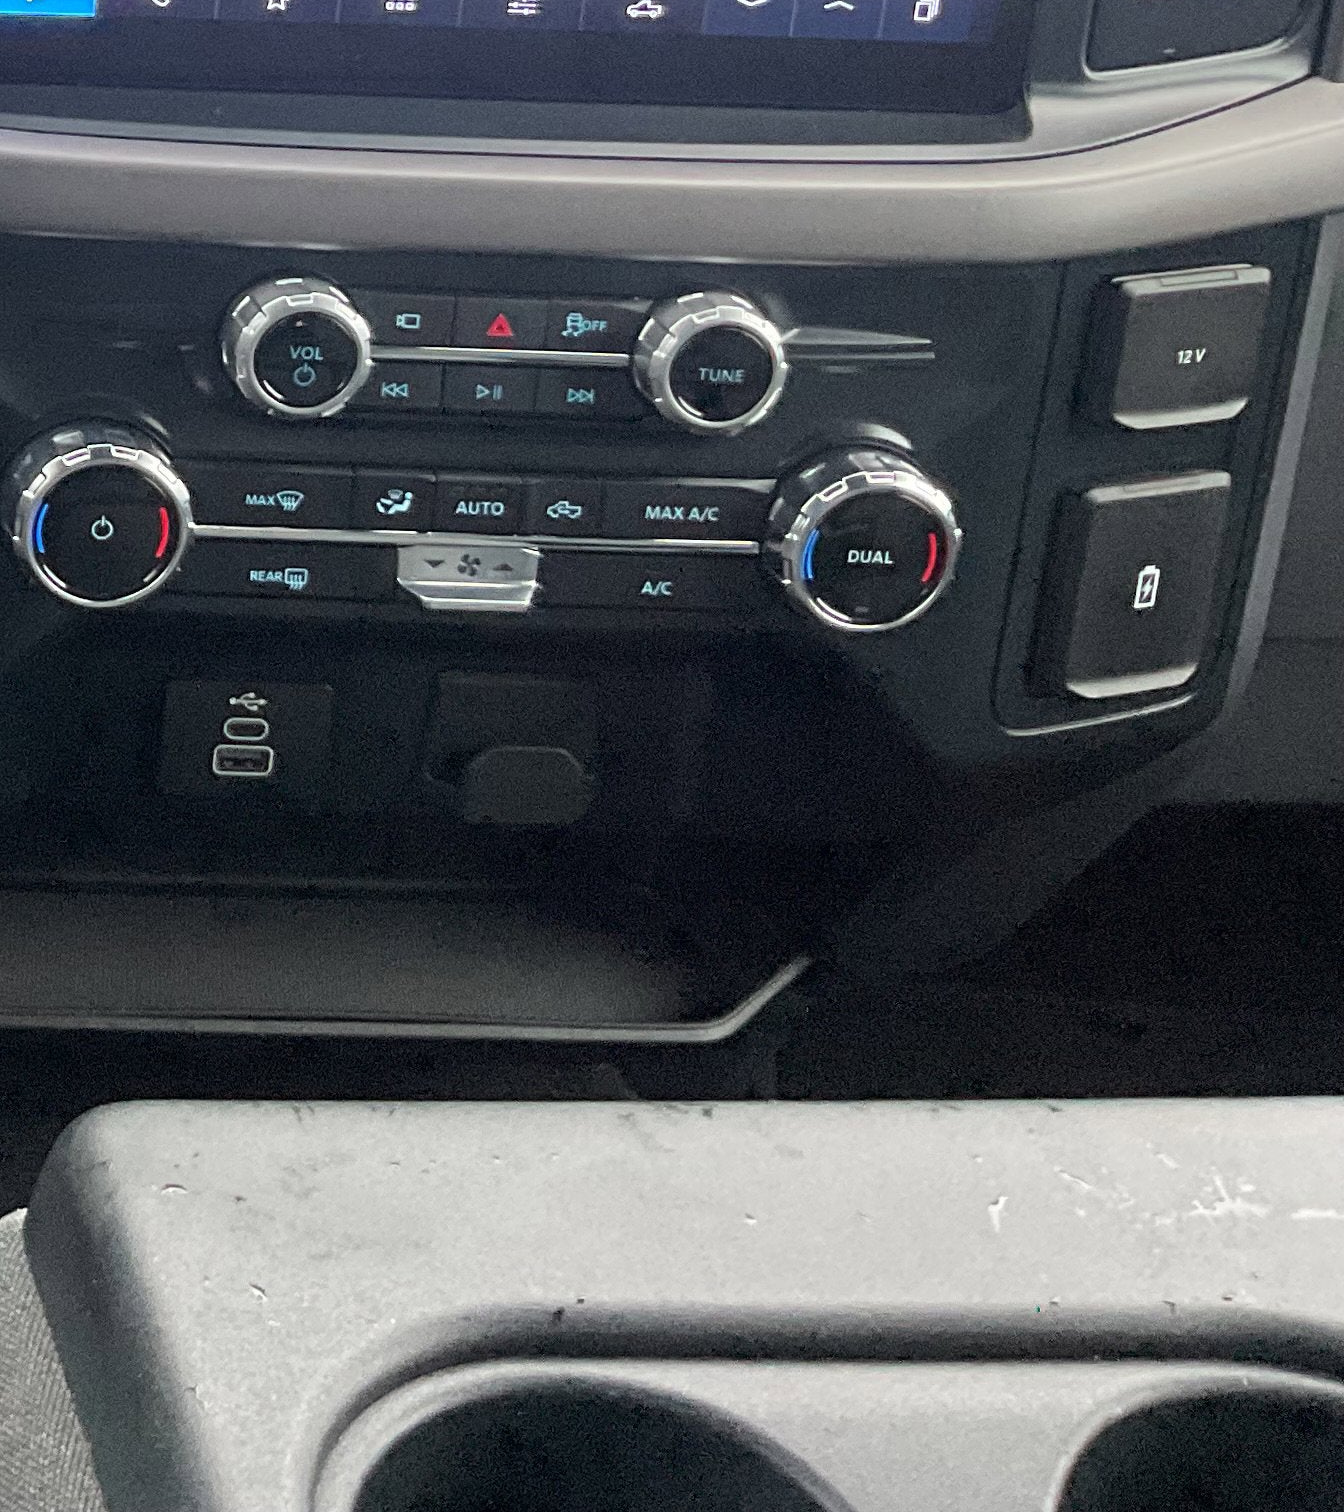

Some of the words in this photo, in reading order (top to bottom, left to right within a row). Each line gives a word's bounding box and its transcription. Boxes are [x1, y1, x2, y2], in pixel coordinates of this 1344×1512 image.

[583, 319, 608, 333] OFF
[290, 345, 324, 361] VOL
[698, 367, 745, 383] TUNE
[245, 494, 276, 506] MAX
[455, 501, 505, 516] AUTO
[644, 505, 684, 520] MAX
[687, 506, 719, 523] A/C
[847, 549, 894, 565] DUAL
[249, 570, 283, 582] REAR
[641, 581, 672, 596] A/C
